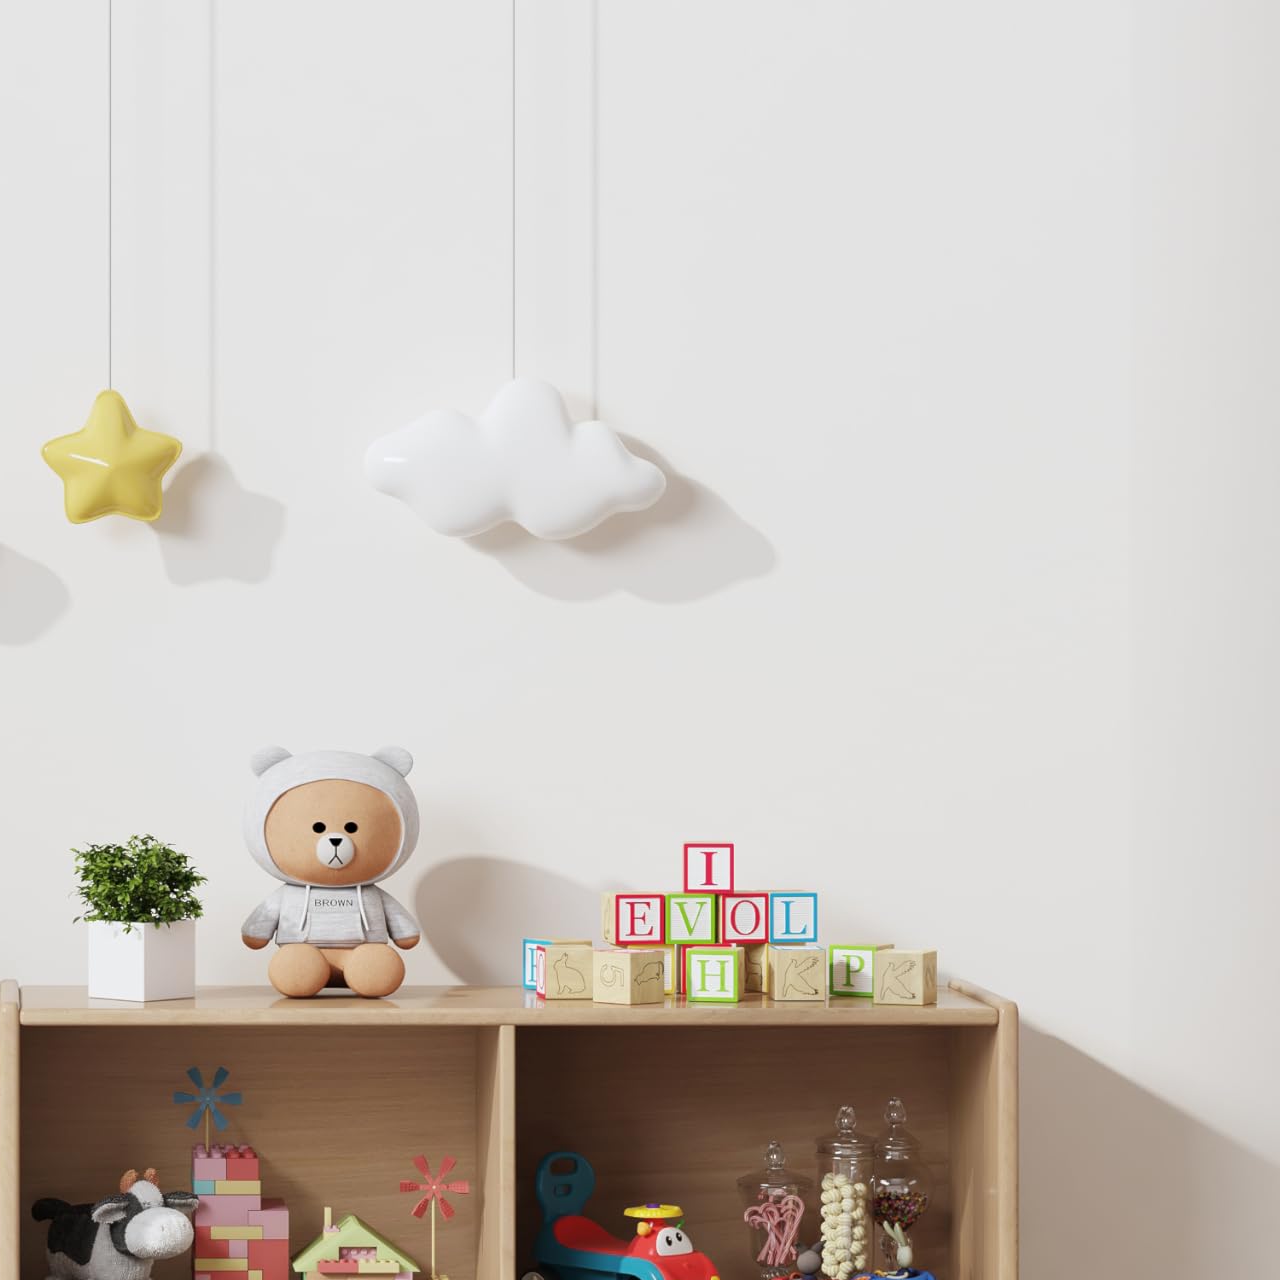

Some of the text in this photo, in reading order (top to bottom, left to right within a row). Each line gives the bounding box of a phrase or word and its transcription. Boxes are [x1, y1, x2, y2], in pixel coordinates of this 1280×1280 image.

[700, 851, 718, 886] I
[314, 898, 353, 907] BROWN
[696, 959, 729, 992] H
[842, 954, 865, 988] P
